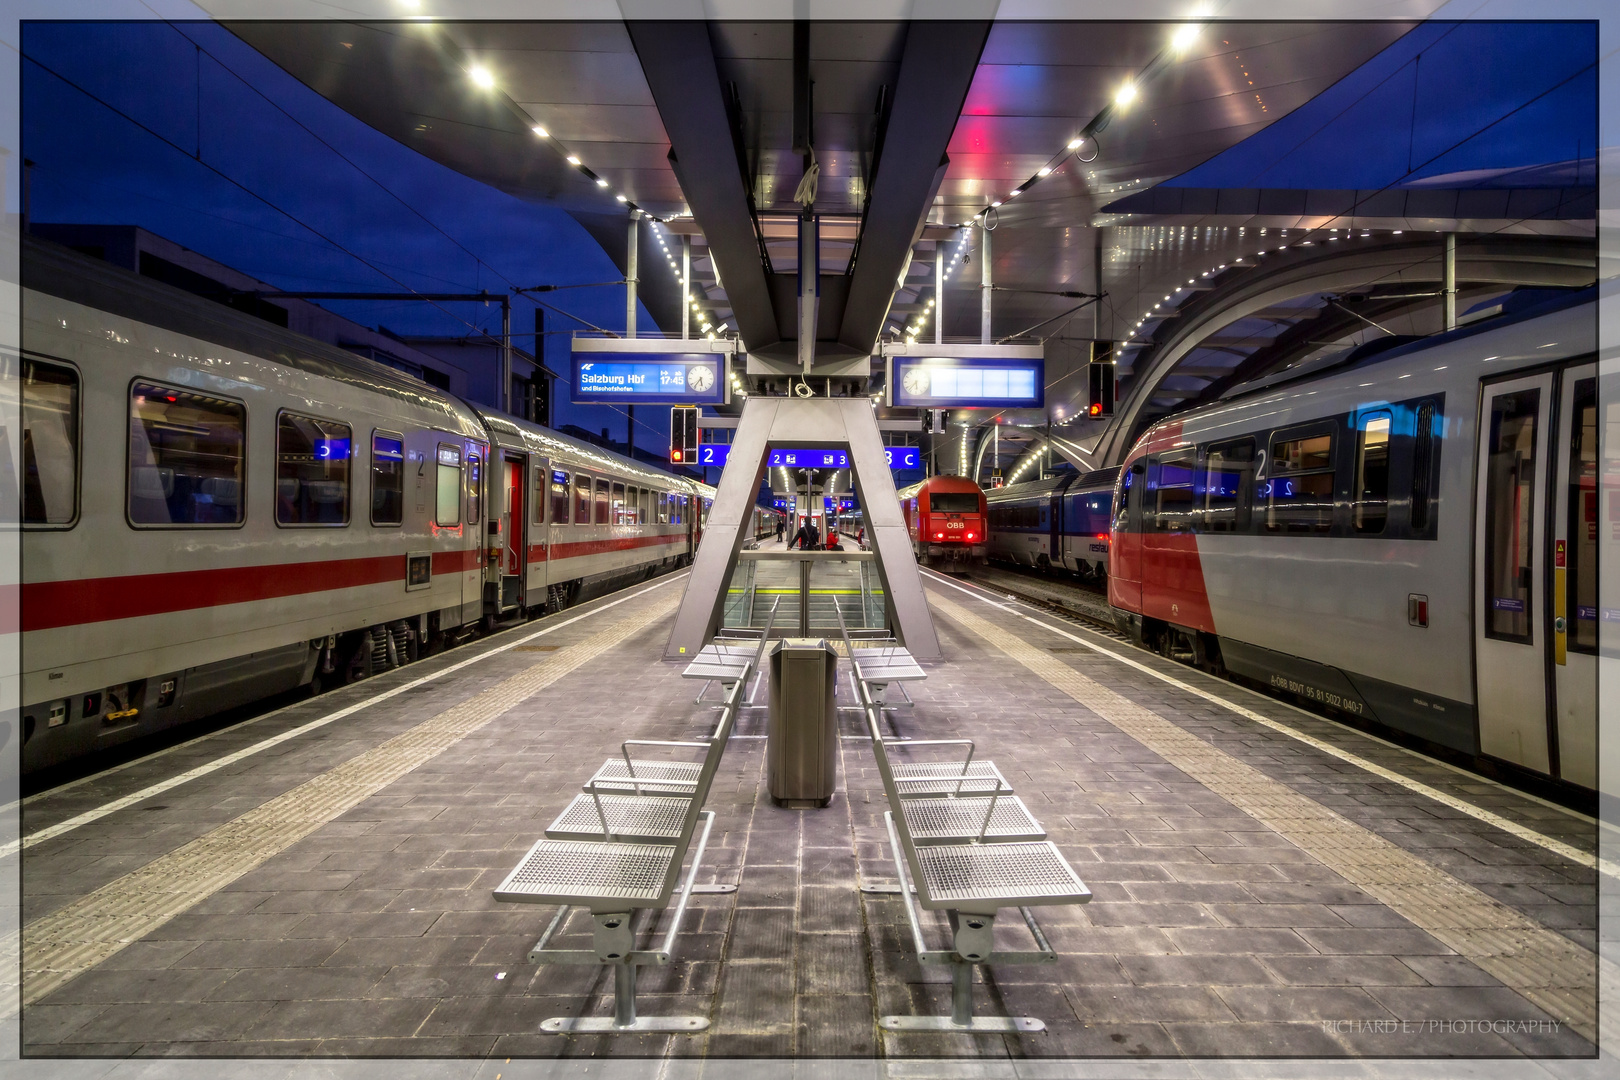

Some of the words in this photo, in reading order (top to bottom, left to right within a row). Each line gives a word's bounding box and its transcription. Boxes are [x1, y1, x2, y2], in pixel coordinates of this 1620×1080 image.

[581, 374, 625, 385] Salzburg
[627, 374, 645, 384] Hbf
[660, 376, 684, 385] 17:45
[704, 448, 714, 463] 2
[773, 454, 781, 464] 2
[839, 455, 846, 465] 3
[904, 454, 914, 466] C
[417, 455, 424, 477] 2
[1255, 449, 1267, 481] 2
[1306, 687, 1315, 698] 95
[1316, 690, 1324, 701] 81
[1325, 692, 1341, 707] 5022
[1343, 698, 1363, 714] 040-7
